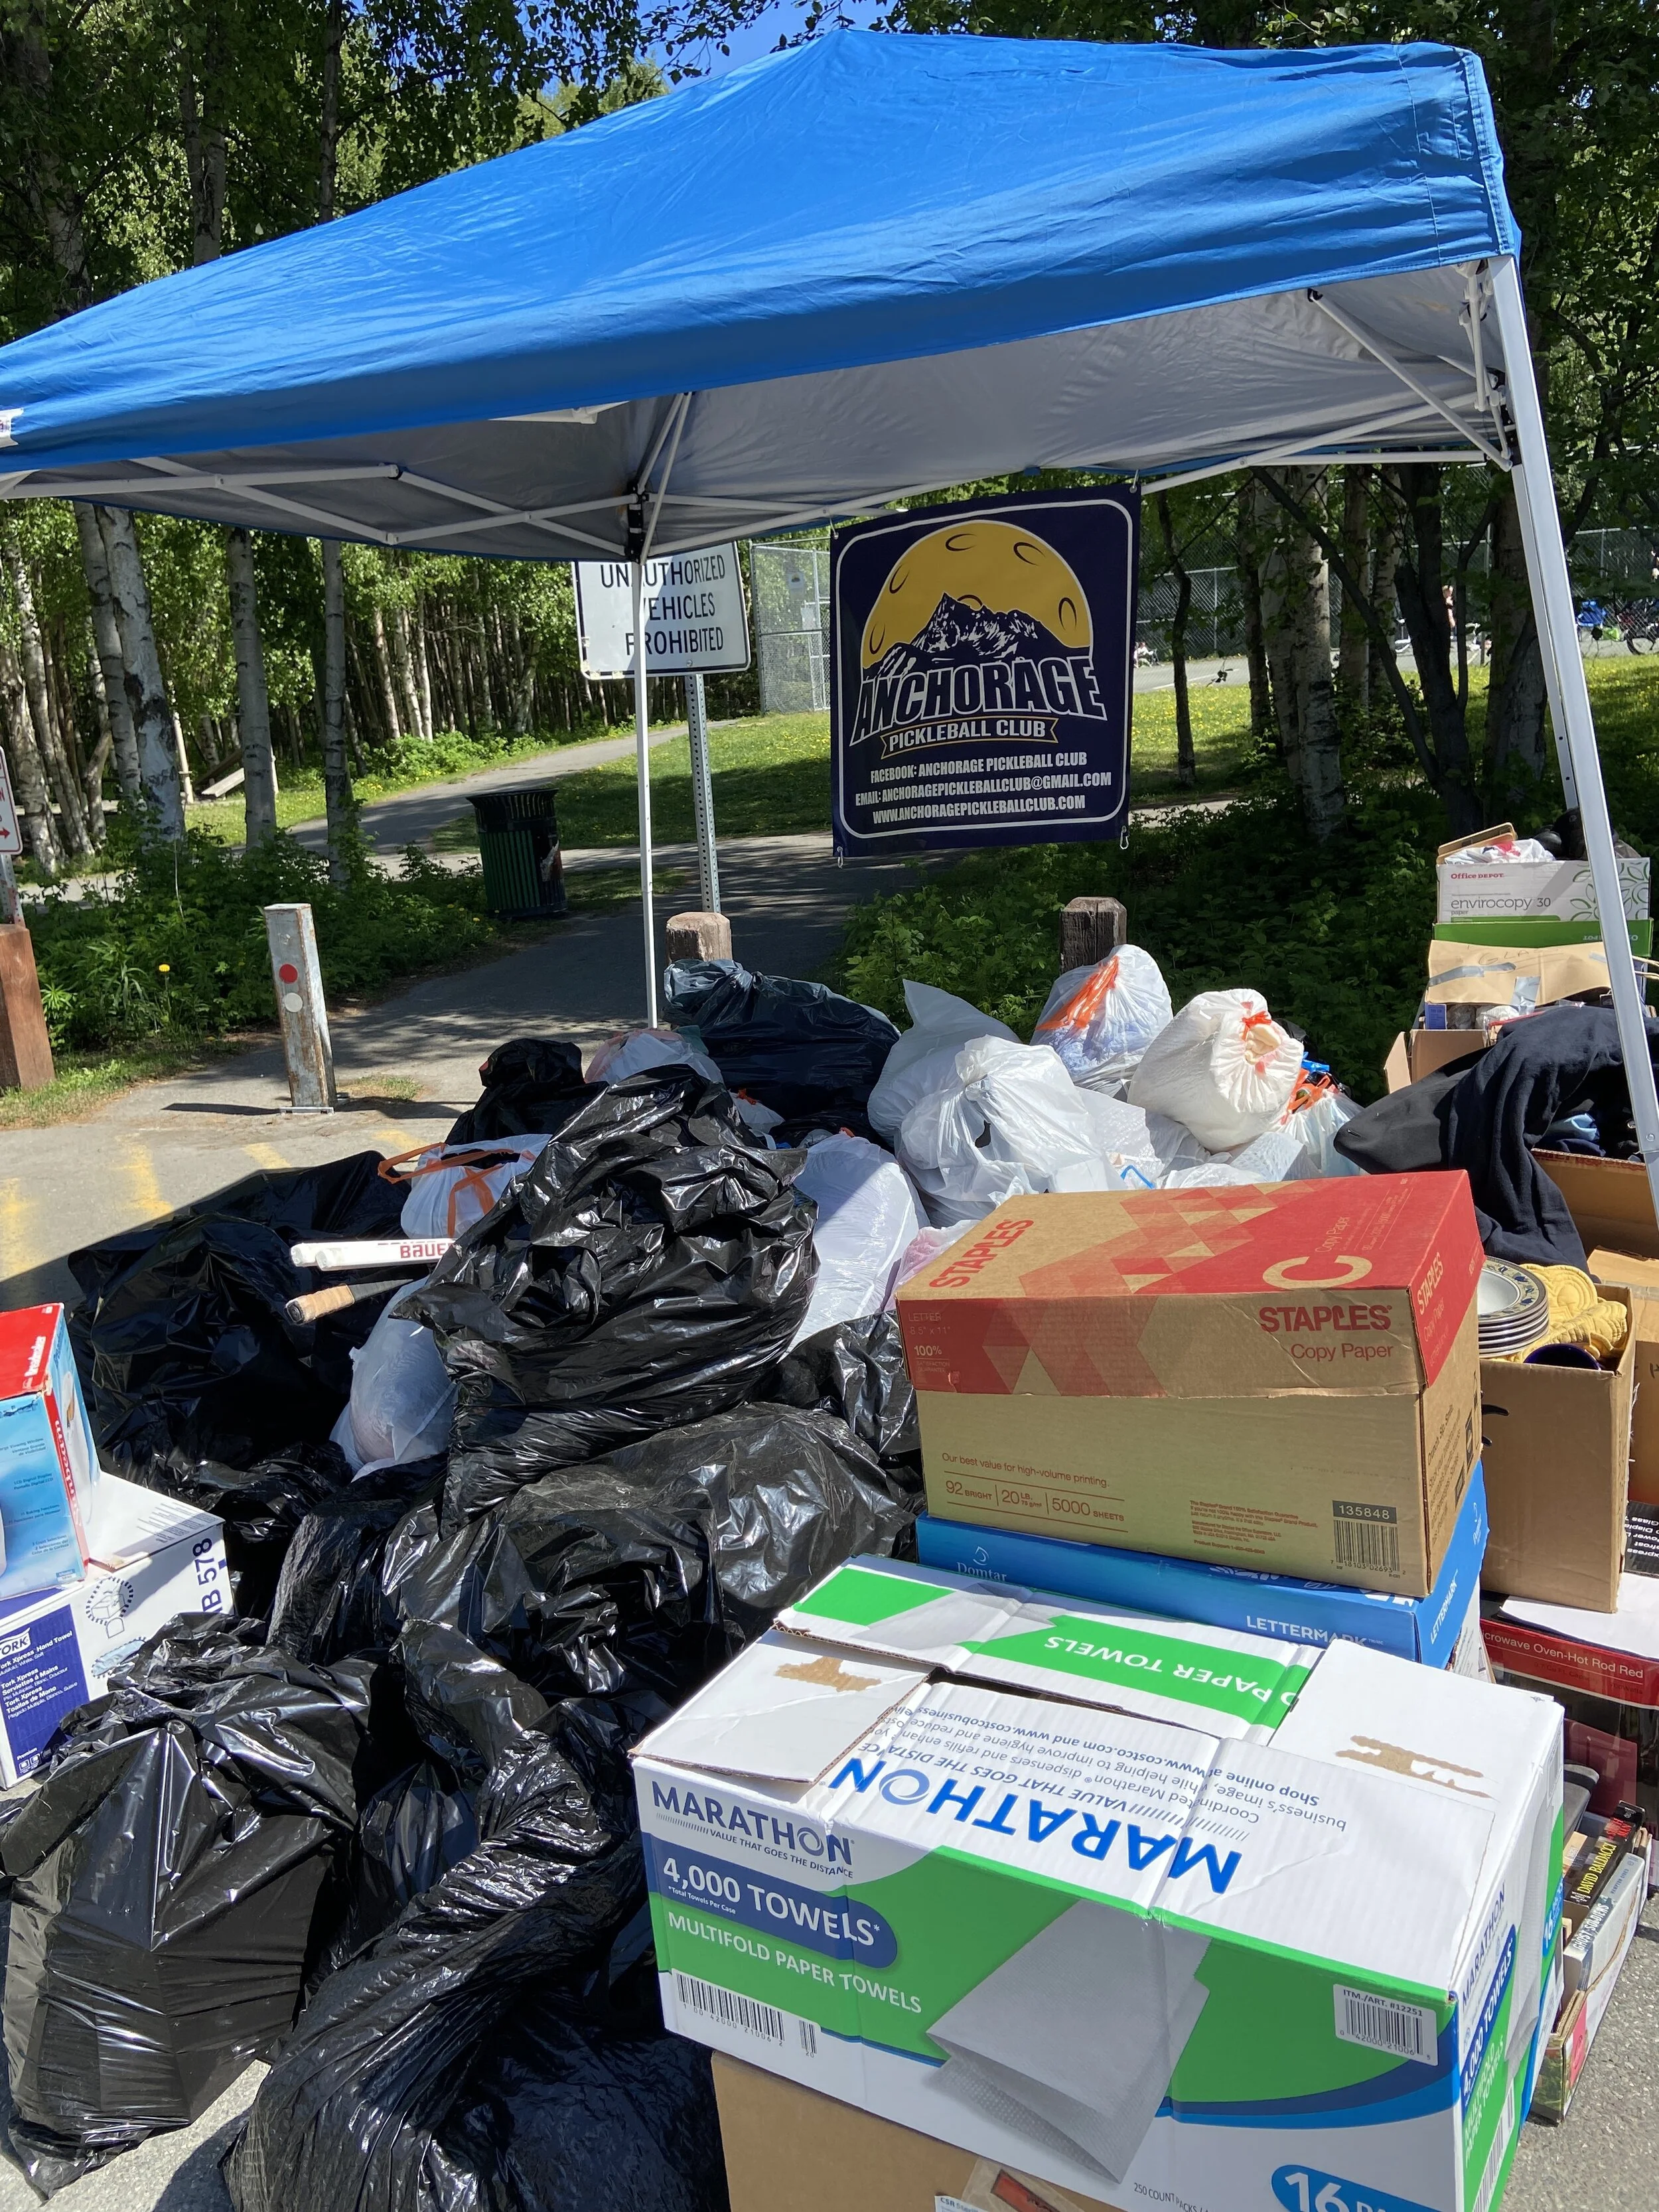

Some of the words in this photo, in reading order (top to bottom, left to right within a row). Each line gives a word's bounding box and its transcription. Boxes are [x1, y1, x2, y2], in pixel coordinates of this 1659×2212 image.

[643, 592, 715, 621] EHICLES
[849, 656, 1107, 746] ANCHORAGE
[889, 720, 991, 752] PICKLEBALL
[996, 717, 1046, 737] CLUB
[871, 765, 917, 783] FACEBOOK:
[918, 757, 983, 777] ANCHORAGE
[986, 753, 1052, 772] PICKLEBALL
[1055, 751, 1087, 767] CLUB
[855, 791, 882, 806] EMAIL:
[873, 795, 1085, 824] WWW.ANCHORAGEPICKLEBALLCLUB.COM
[1451, 896, 1533, 911] envirocopy
[1537, 897, 1550, 907] 30
[929, 1218, 1034, 1288] STAPLES
[1315, 1235, 1342, 1252] Copy
[1417, 1252, 1443, 1315] STAPLES
[908, 1313, 941, 1321] LETTER
[1260, 1305, 1390, 1332] STAPLES
[914, 1345, 942, 1356] 100%
[1292, 1343, 1338, 1362] Copy
[1342, 1342, 1393, 1361] Paper
[942, 1452, 958, 1463] Our
[960, 1455, 977, 1466] best
[979, 1458, 1002, 1470] value
[1003, 1462, 1015, 1472] for
[1017, 1464, 1071, 1481] high-volume
[1074, 1473, 1110, 1489] printing.
[946, 1480, 964, 1495] 92
[965, 1489, 992, 1500] BRIGHT
[1001, 1489, 1019, 1505] 20
[1021, 1491, 1033, 1500] LB.
[1052, 1497, 1091, 1516] 5000
[1093, 1510, 1125, 1521] SHEETS
[1339, 1505, 1390, 1520] 135848
[1632, 1517, 1659, 1526] Glass
[1633, 1533, 1659, 1542] ower
[192, 1538, 217, 1585] 578
[957, 1562, 1007, 1582] Domtar
[1344, 1560, 1366, 1570] 18103
[1370, 1564, 1393, 1573] 02693
[1431, 1579, 1459, 1645] LETTERMARK
[1246, 1615, 1368, 1646] LETTERMARK
[0, 1635, 28, 1655] ORK
[12, 1651, 35, 1664] Xpress
[36, 1640, 53, 1652] Hand
[54, 1631, 73, 1643] Towel
[1044, 1636, 1163, 1673] TOWELS
[1534, 1643, 1589, 1666] Oven-Hot
[1592, 1658, 1616, 1672] Rod
[1620, 1664, 1644, 1678] Red
[1, 1679, 16, 1690] Tork
[17, 1668, 39, 1682] Xpress
[2, 1677, 34, 1696] Serviettes
[40, 1665, 59, 1678] Mains
[1173, 1662, 1273, 1702] PAPER
[5, 1697, 21, 1707] Tork
[21, 1686, 42, 1700] Xpress
[6, 1700, 29, 1714] Toallas
[39, 1686, 57, 1698] Mano
[881, 1716, 904, 1728] osts
[910, 1718, 951, 1735] reduce
[955, 1727, 979, 1740] and
[891, 1731, 942, 1745] enhane
[943, 1740, 979, 1759] refills
[985, 1733, 1034, 1753] hygiene
[1054, 1735, 1080, 1747] and
[934, 1757, 968, 1773] THE
[981, 1750, 1008, 1763] and
[1037, 1745, 1094, 1764] improve
[1084, 1740, 1206, 1778] www.costco.com
[1097, 1759, 1111, 1769] to
[974, 1765, 1018, 1784] GOES
[1009, 1756, 1082, 1778] dispensers
[1114, 1761, 1167, 1783] helping
[1020, 1777, 1066, 1797] THAT
[1094, 1774, 1165, 1800] Marathon
[1226, 1769, 1275, 1792] online
[1069, 1788, 1127, 1811] VALUE
[1214, 1782, 1265, 1806] image,
[1279, 1785, 1320, 1806] Shop
[652, 1781, 853, 1866] MARATHON
[828, 1757, 1242, 1894] MARATHON
[709, 1829, 737, 1844] VALUE
[739, 1838, 762, 1852] THAT
[763, 1845, 788, 1860] GOES
[790, 1854, 808, 1868] THE
[810, 1860, 853, 1879] DISTANCE
[1577, 1871, 1599, 1894] DAVID
[1589, 1842, 1618, 1875] BALDACCI
[664, 1858, 741, 1903] 4,000
[687, 1890, 709, 1905] Towels
[709, 1899, 721, 1909] Per
[721, 1903, 736, 1915] Case
[1573, 1922, 1593, 1951] GHOST
[1589, 1903, 1610, 1934] SOLDIERS
[1462, 1881, 1506, 2013] MARATHON
[668, 1911, 770, 1961] MULTIFOLD
[775, 1949, 835, 1987] PAPER
[839, 1973, 922, 2014] TOWELS
[1343, 1989, 1388, 2007] ITM./ART.
[1390, 2002, 1423, 2017] #12251
[709, 2014, 737, 2029] 42000
[744, 2026, 772, 2042] 21006
[1356, 2033, 1383, 2046] 42000
[1387, 2042, 1415, 2056] 21006
[1463, 2035, 1484, 2097] 4,000
[1133, 2182, 1147, 2195] 250
[1149, 2188, 1175, 2203] COUNT
[1285, 2172, 1350, 2212] 16
